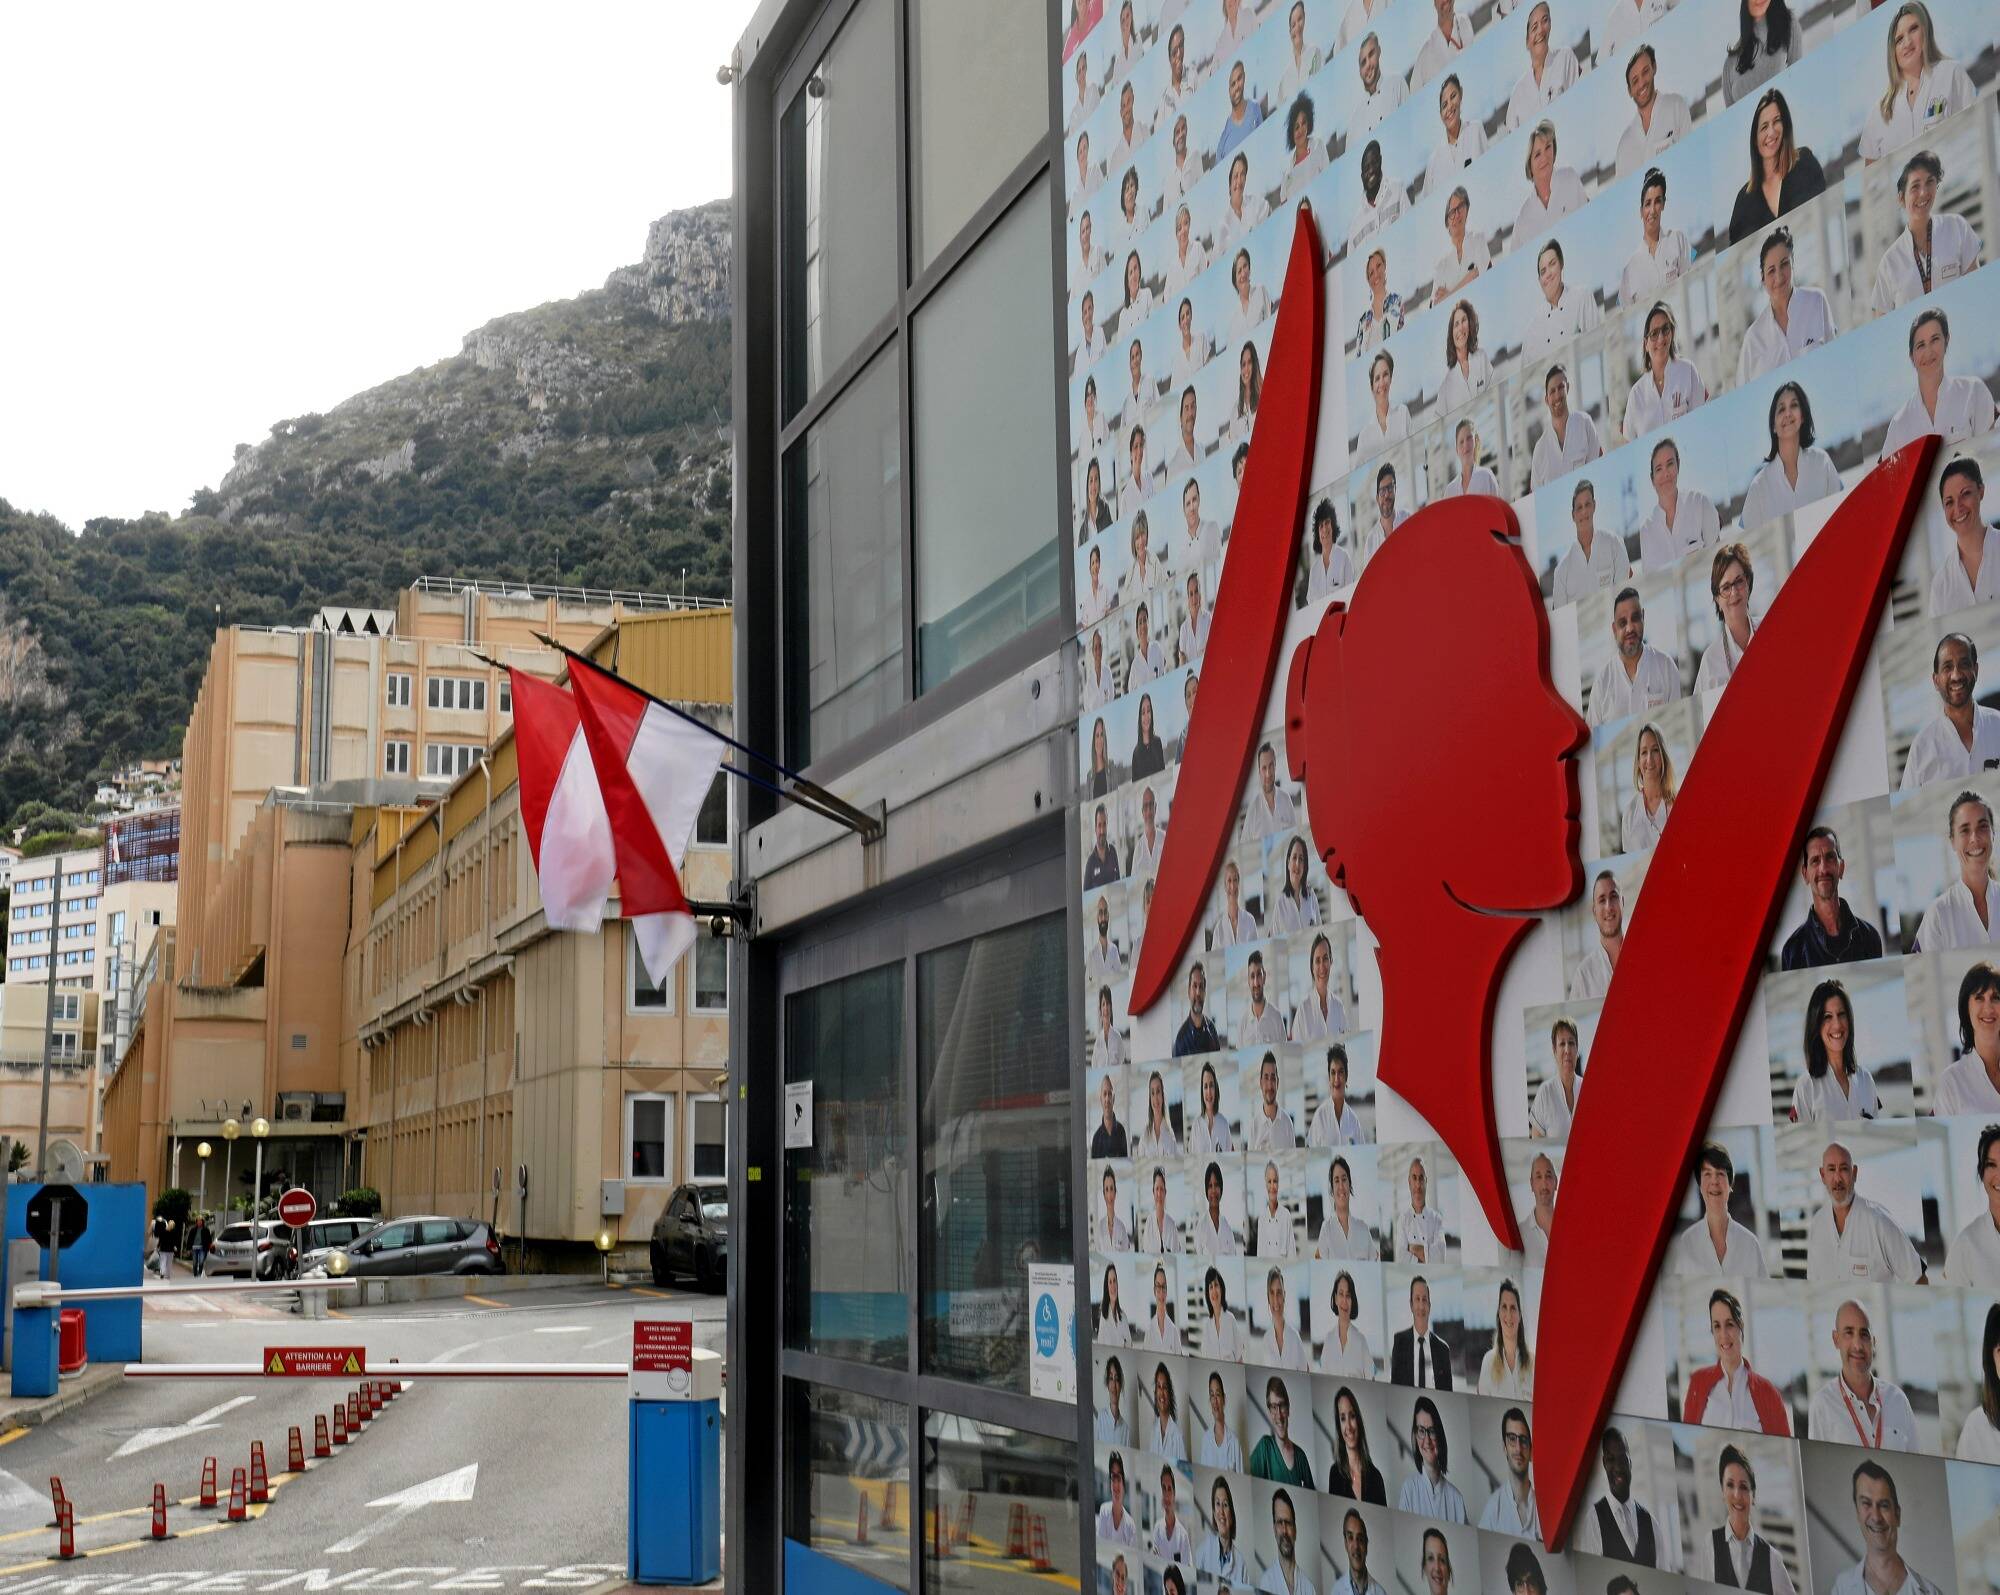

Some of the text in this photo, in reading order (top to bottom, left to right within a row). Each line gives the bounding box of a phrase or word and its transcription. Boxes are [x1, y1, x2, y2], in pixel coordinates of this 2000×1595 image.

[285, 1351, 343, 1361] ATTENTION A LA
[295, 1362, 332, 1372] BARRIERE
